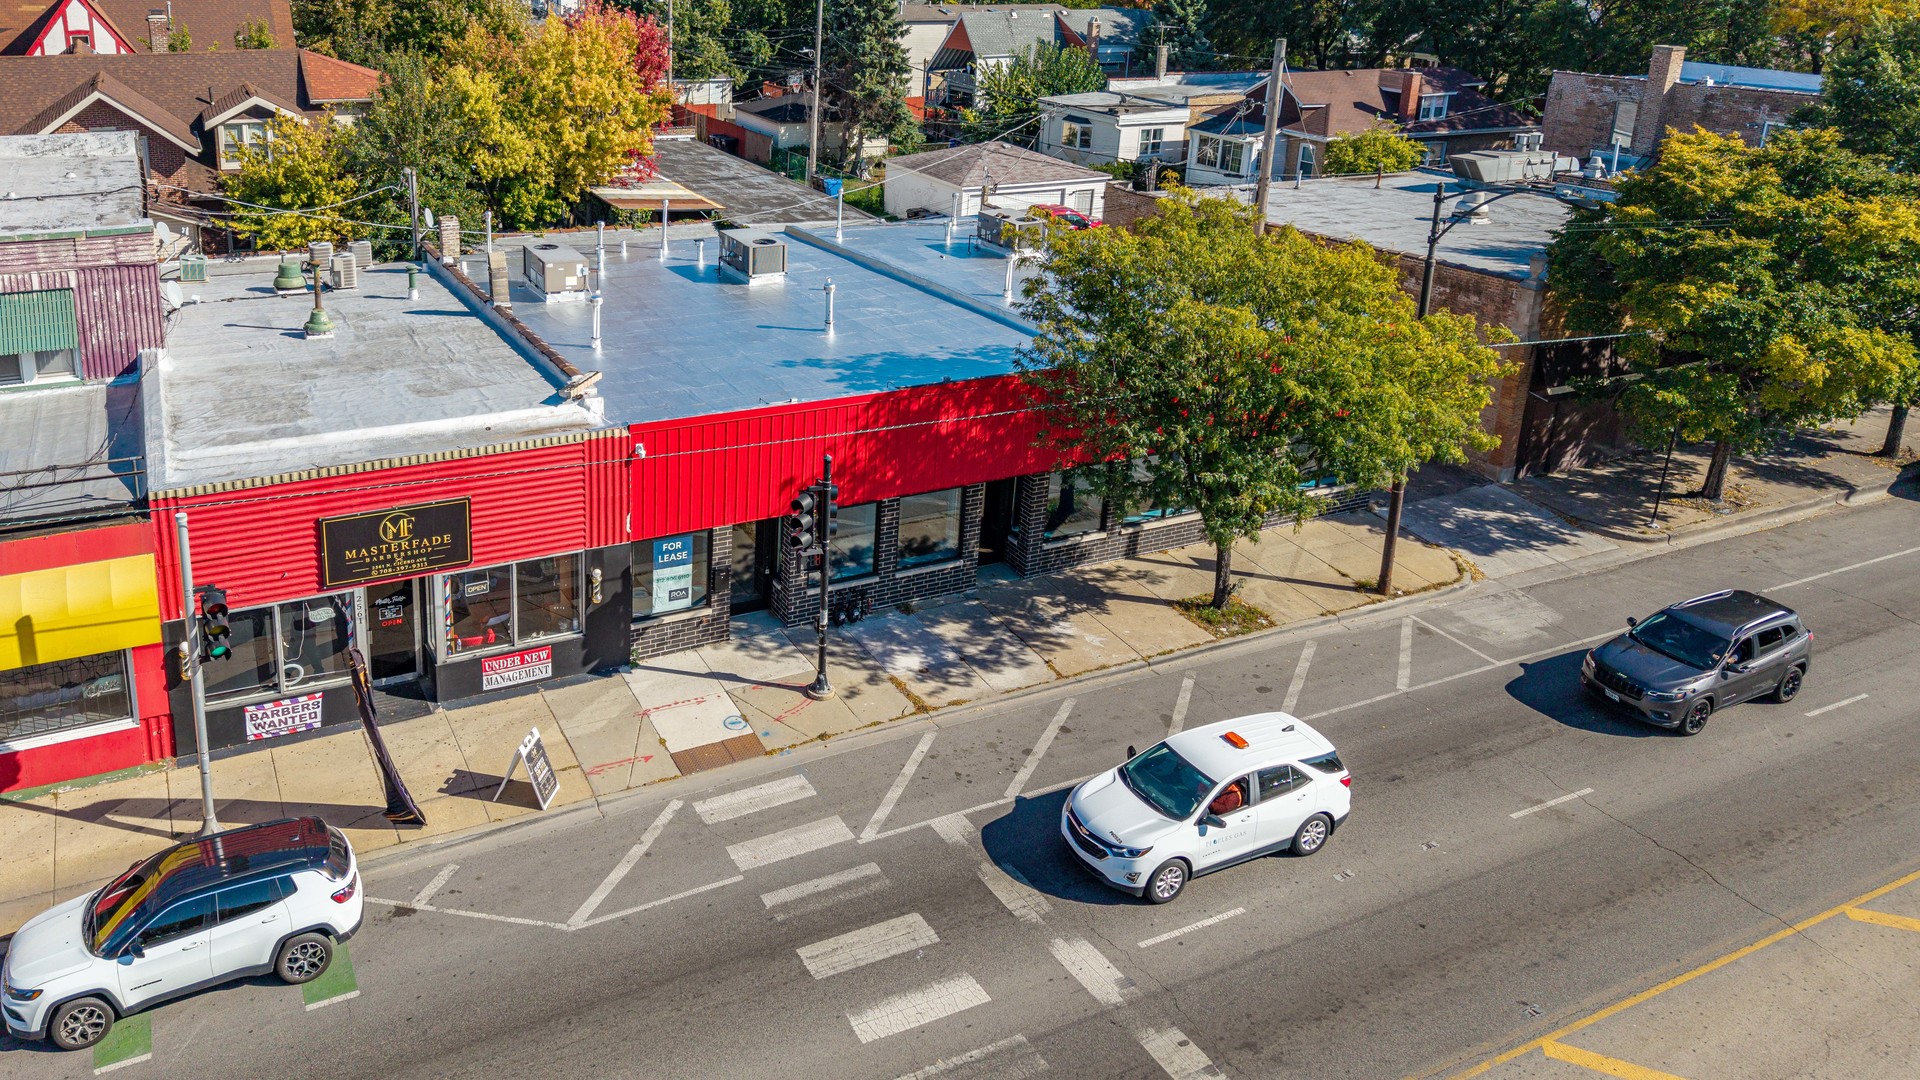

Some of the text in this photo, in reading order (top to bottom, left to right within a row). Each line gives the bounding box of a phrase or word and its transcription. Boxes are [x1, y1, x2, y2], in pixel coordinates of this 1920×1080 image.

[345, 534, 452, 560] MASTERFADE
[365, 547, 433, 563] BARBERSHOP
[662, 541, 682, 552] FOR
[658, 551, 688, 563] LEASE
[467, 583, 487, 593] OPEN
[381, 618, 403, 627] OPEN
[484, 649, 549, 672] UNDER NEW
[485, 664, 550, 687] MANAGEMENT
[249, 700, 321, 722] BARBERS
[253, 711, 318, 731] WANTED
